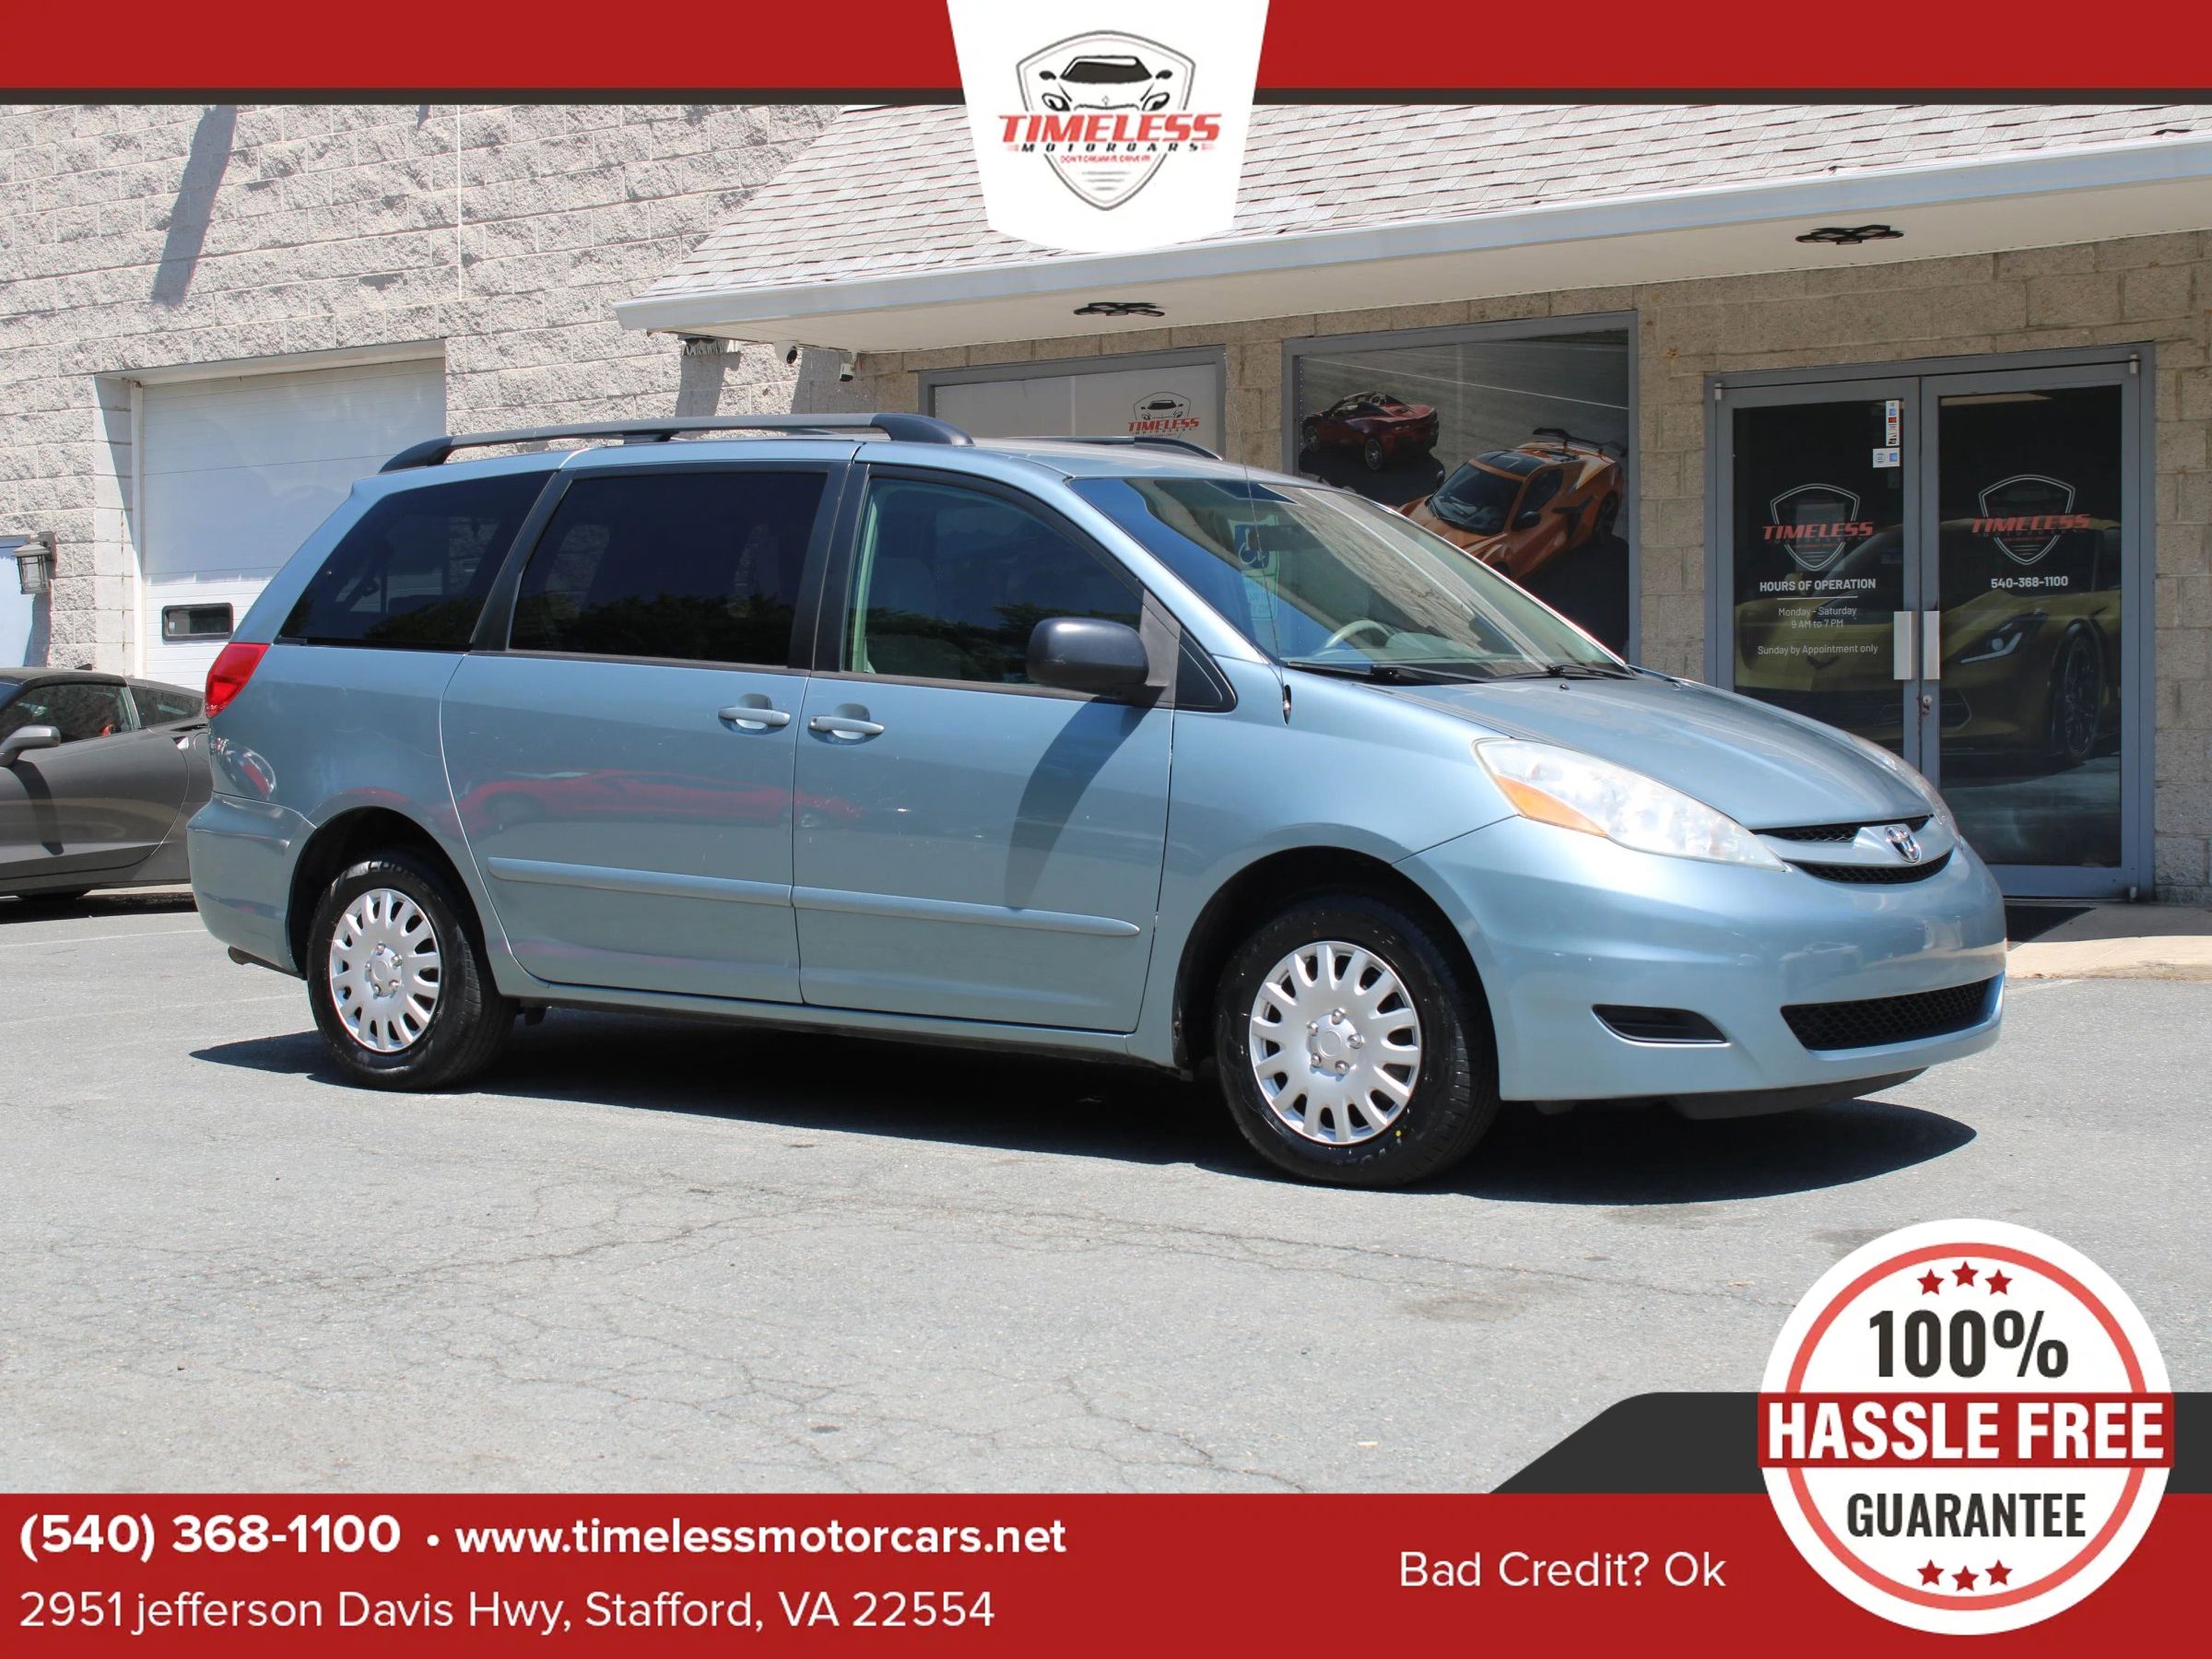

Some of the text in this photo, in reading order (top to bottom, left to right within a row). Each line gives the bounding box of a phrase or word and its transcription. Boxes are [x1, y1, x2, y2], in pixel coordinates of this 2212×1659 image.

[1127, 418, 1200, 432] TIMELESS
[1971, 514, 2091, 534] TIMELESS
[1762, 522, 1874, 540] TIMELESS
[1759, 579, 1877, 592] HOURS OF OPERATION
[1991, 575, 2069, 589] 540-368-1100
[1778, 607, 1811, 618] Monday
[1818, 606, 1857, 617] Saturday
[1791, 620, 1796, 629] 9
[1798, 619, 1811, 629] AM
[1830, 618, 1843, 628] PM
[1757, 644, 1878, 656] Sunday by Appointment only
